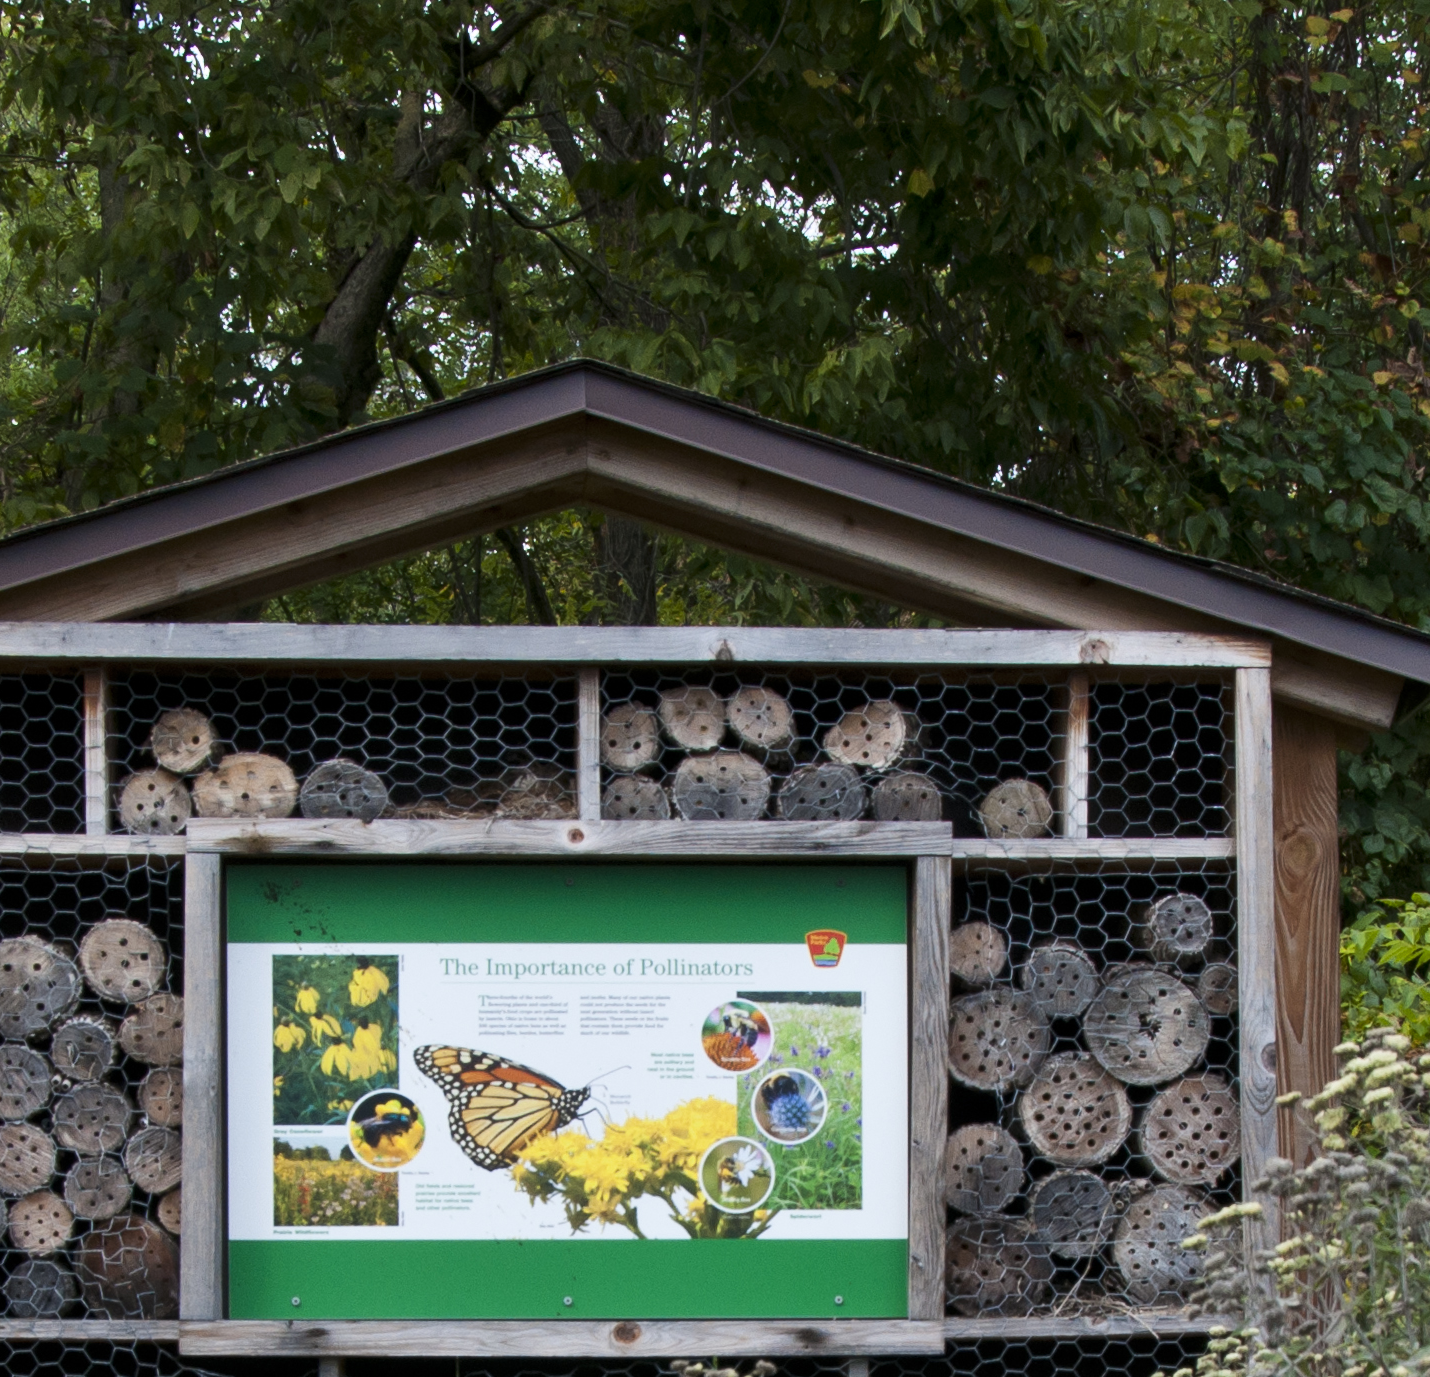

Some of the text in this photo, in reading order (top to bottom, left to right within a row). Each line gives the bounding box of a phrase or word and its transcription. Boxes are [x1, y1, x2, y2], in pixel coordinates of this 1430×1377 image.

[440, 958, 754, 980] The Importance of Pollinators
